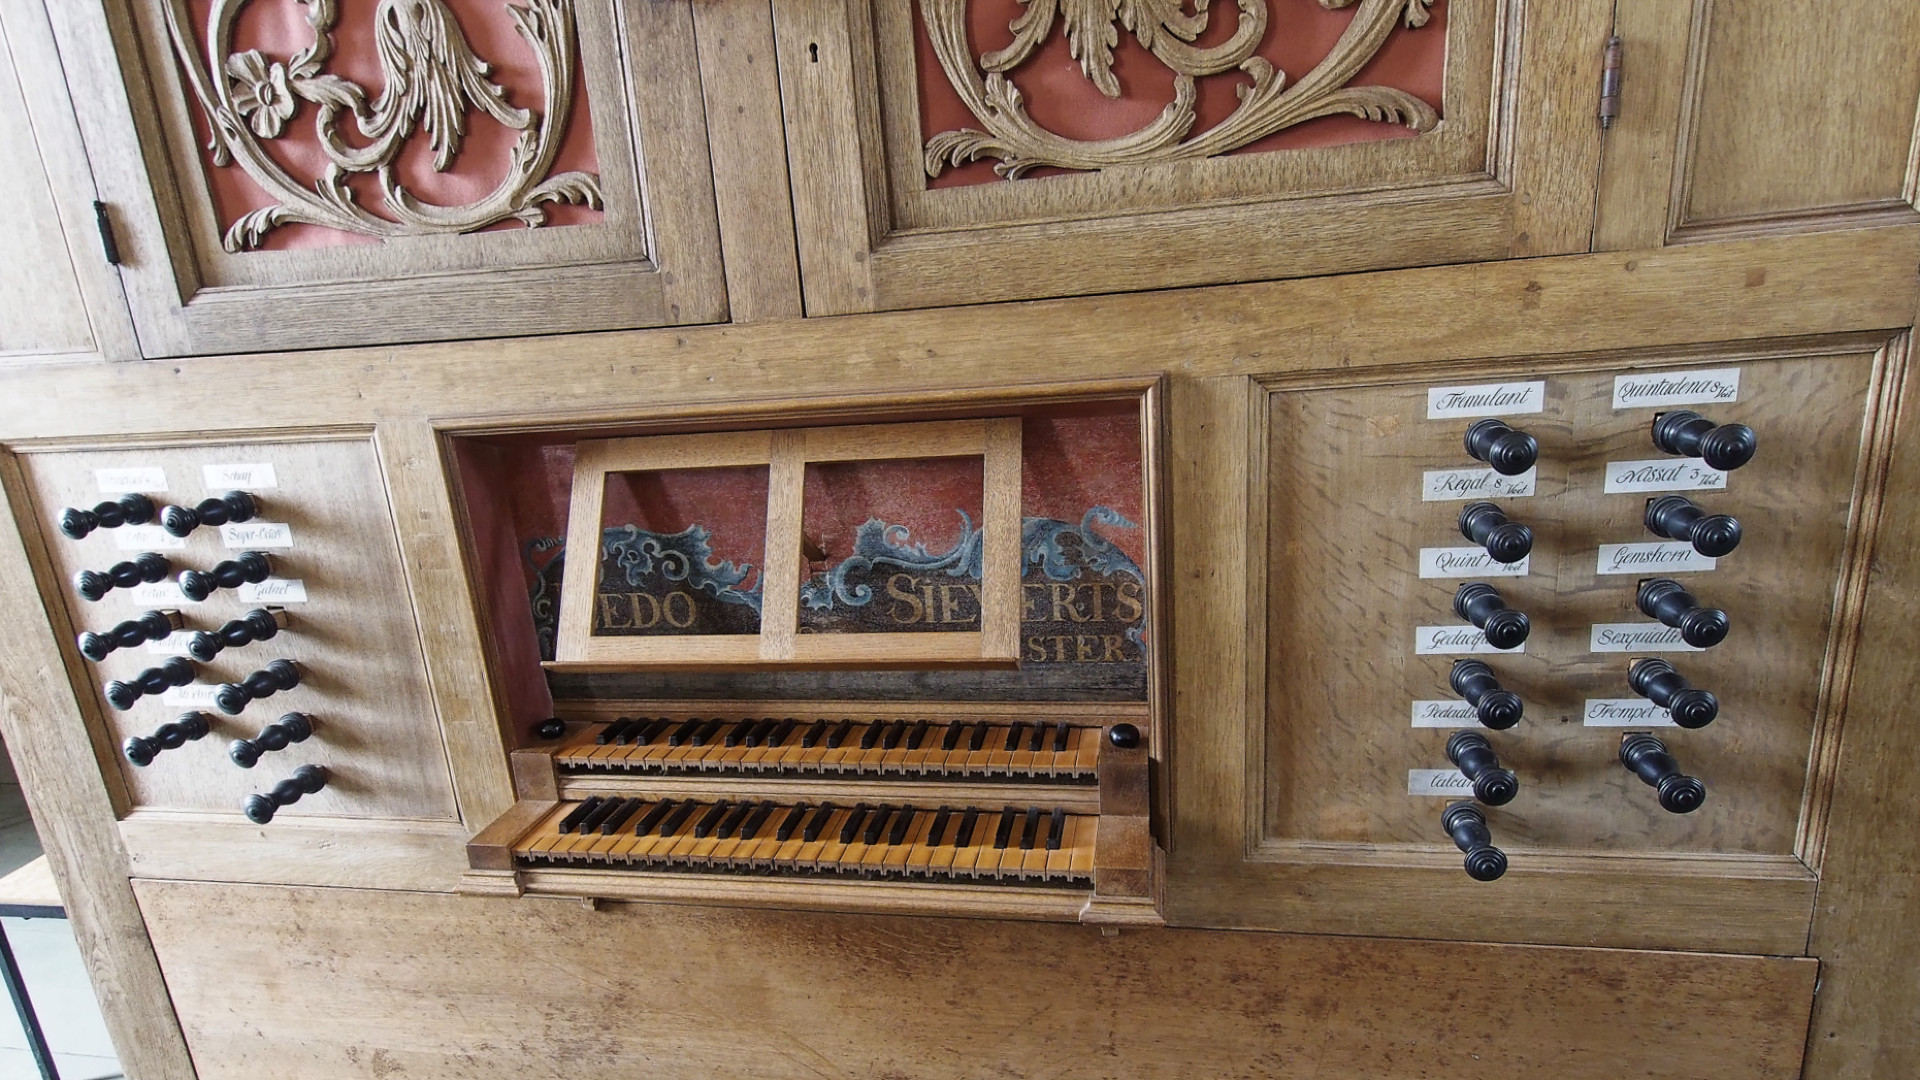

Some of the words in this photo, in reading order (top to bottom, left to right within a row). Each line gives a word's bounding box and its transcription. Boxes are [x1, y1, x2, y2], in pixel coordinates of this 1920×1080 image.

[1436, 386, 1533, 411] Tremulant
[1618, 377, 1712, 402] Quintadena
[1710, 381, 1721, 393] 8
[1433, 472, 1492, 497] Regal
[1494, 479, 1502, 488] 8
[1615, 463, 1688, 484] Nassat
[1689, 468, 1700, 480] 3
[1435, 552, 1488, 573] Quint
[1608, 544, 1693, 572] Gemshorn
